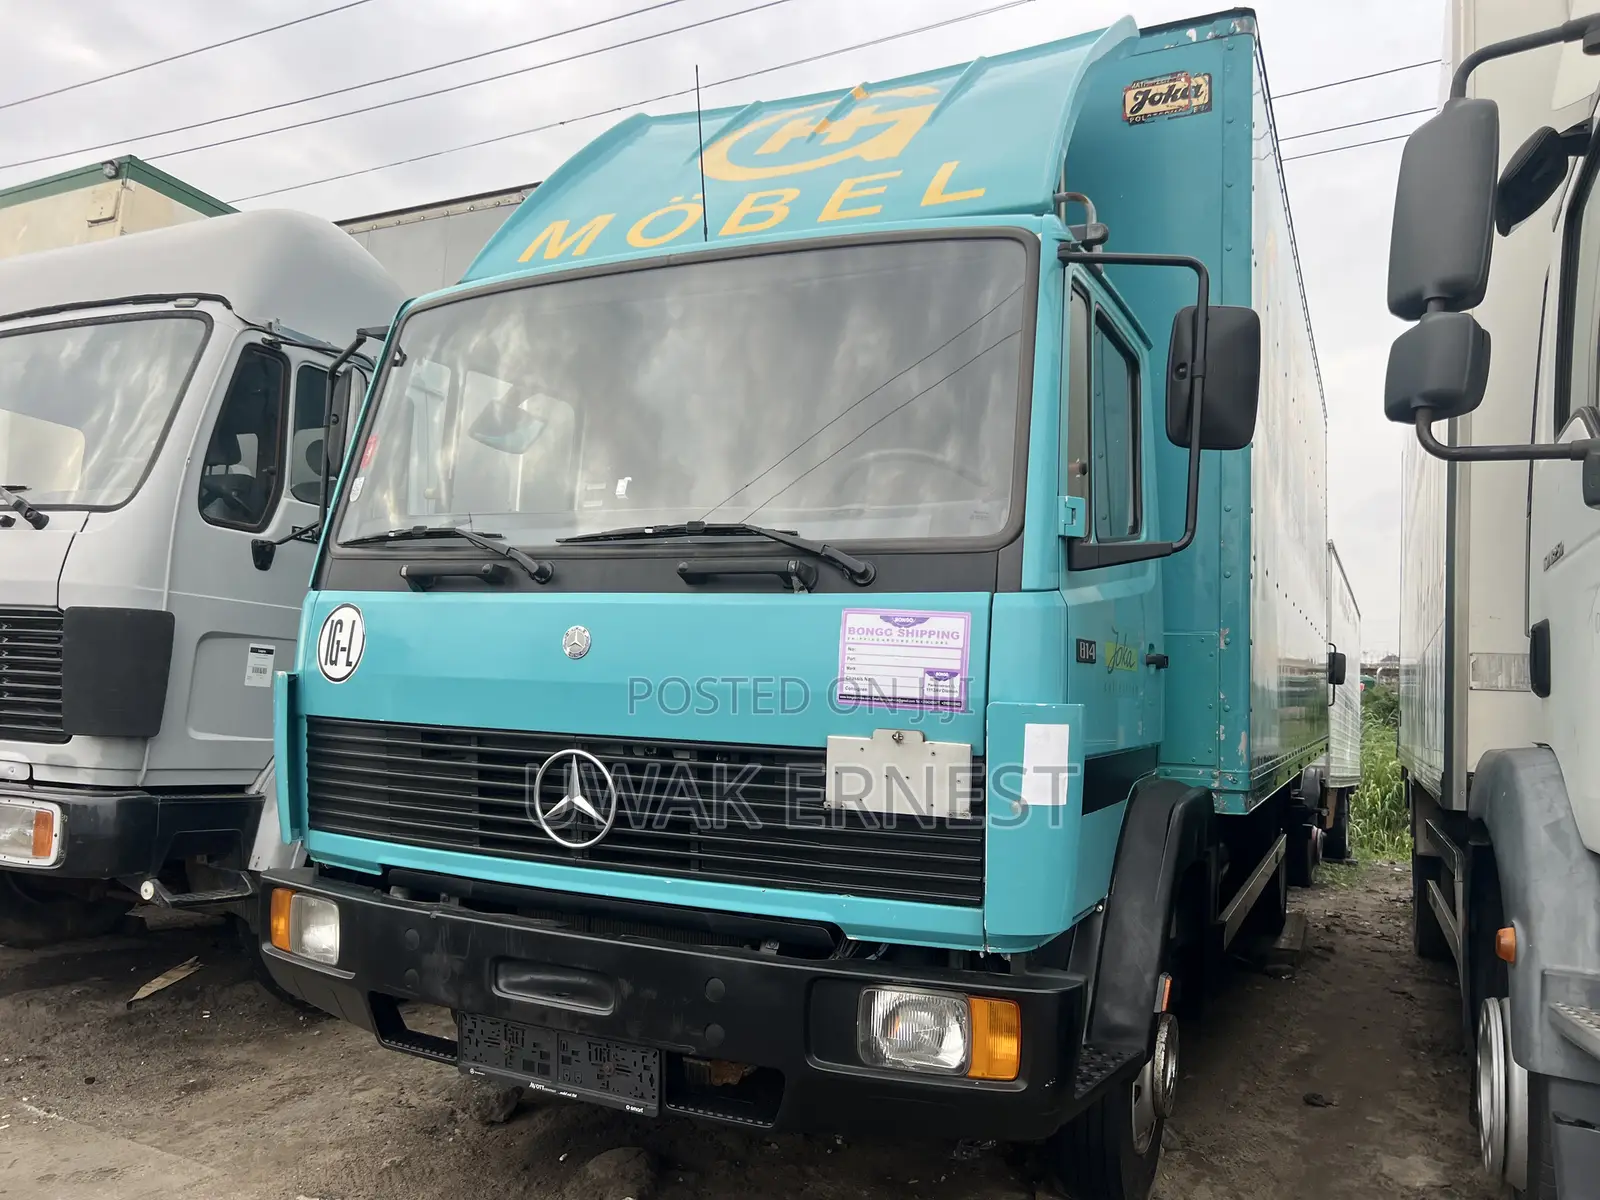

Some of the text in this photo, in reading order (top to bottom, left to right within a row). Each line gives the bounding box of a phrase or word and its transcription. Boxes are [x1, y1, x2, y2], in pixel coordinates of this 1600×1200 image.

[517, 160, 986, 263] MÖBEL
[324, 618, 356, 667] IG-L
[897, 628, 960, 640] SHIPPING
[1079, 641, 1095, 660] 814
